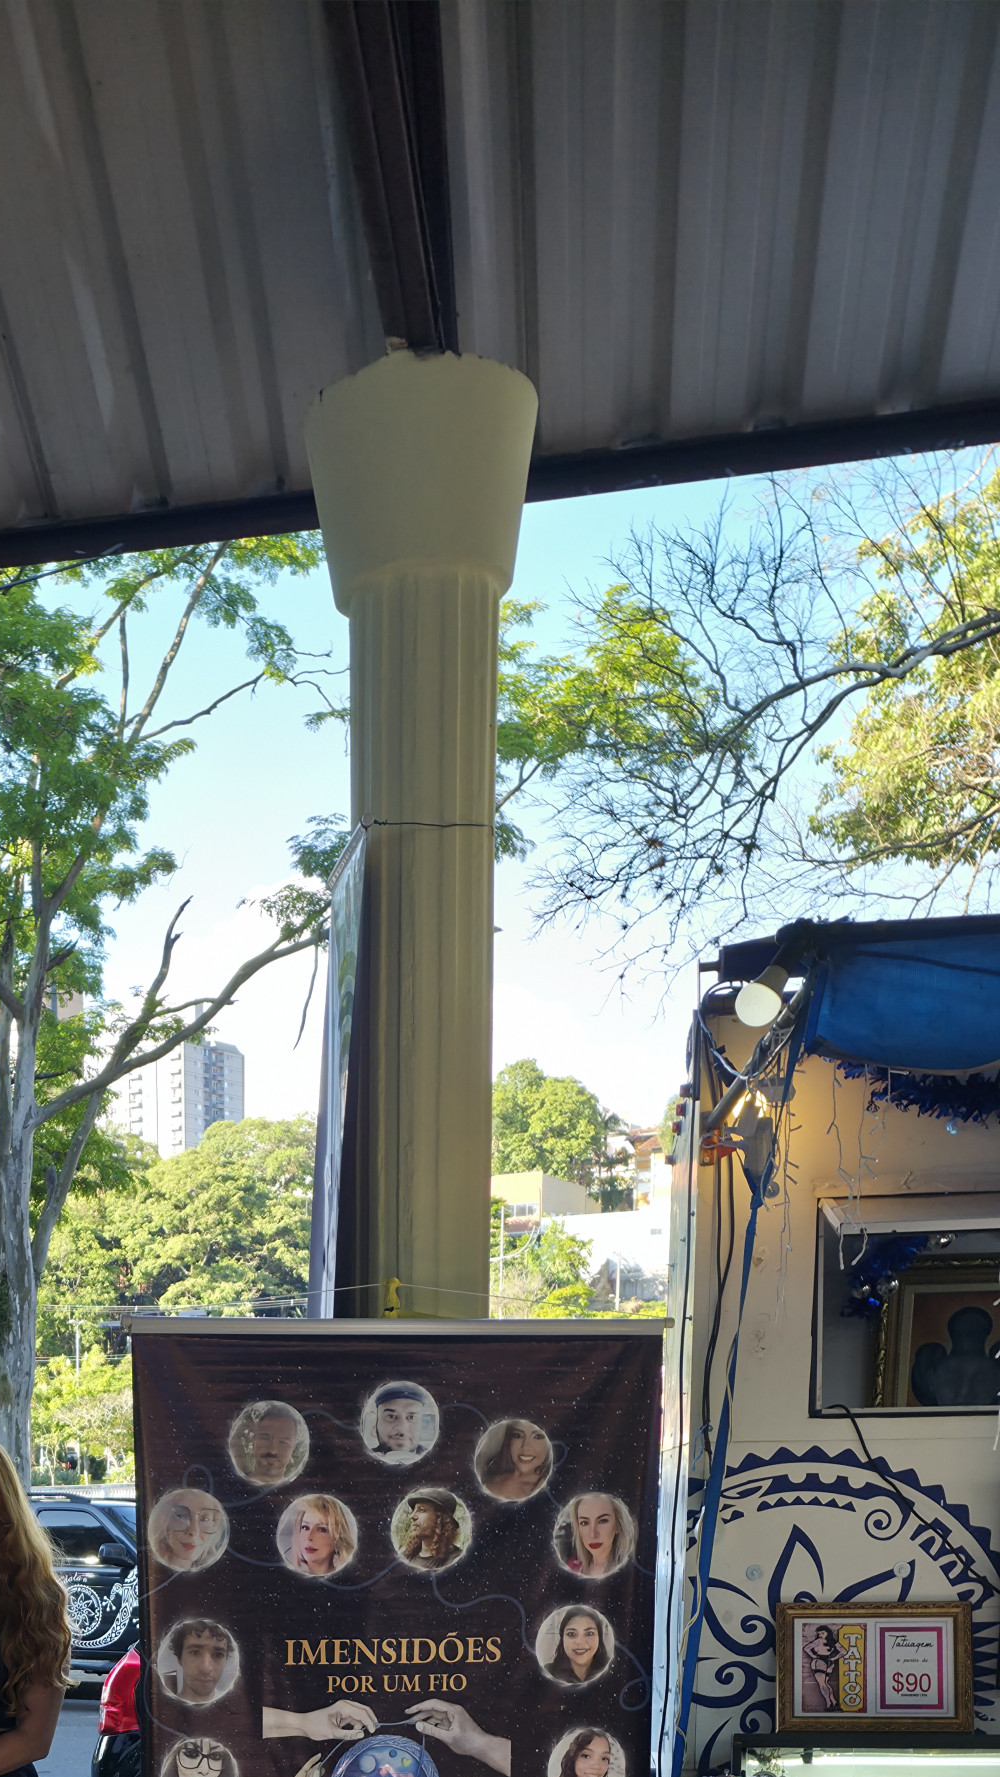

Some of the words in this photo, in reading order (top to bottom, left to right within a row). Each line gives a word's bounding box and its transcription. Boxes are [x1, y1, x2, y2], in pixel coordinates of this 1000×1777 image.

[284, 1631, 502, 1666] IMENSIDÕES
[888, 1634, 934, 1654] Tatuagem
[843, 1633, 861, 1706] TATTOO
[326, 1675, 378, 1693] POR
[382, 1674, 421, 1693] UM
[427, 1673, 468, 1692] FIO
[891, 1671, 931, 1694] $90
